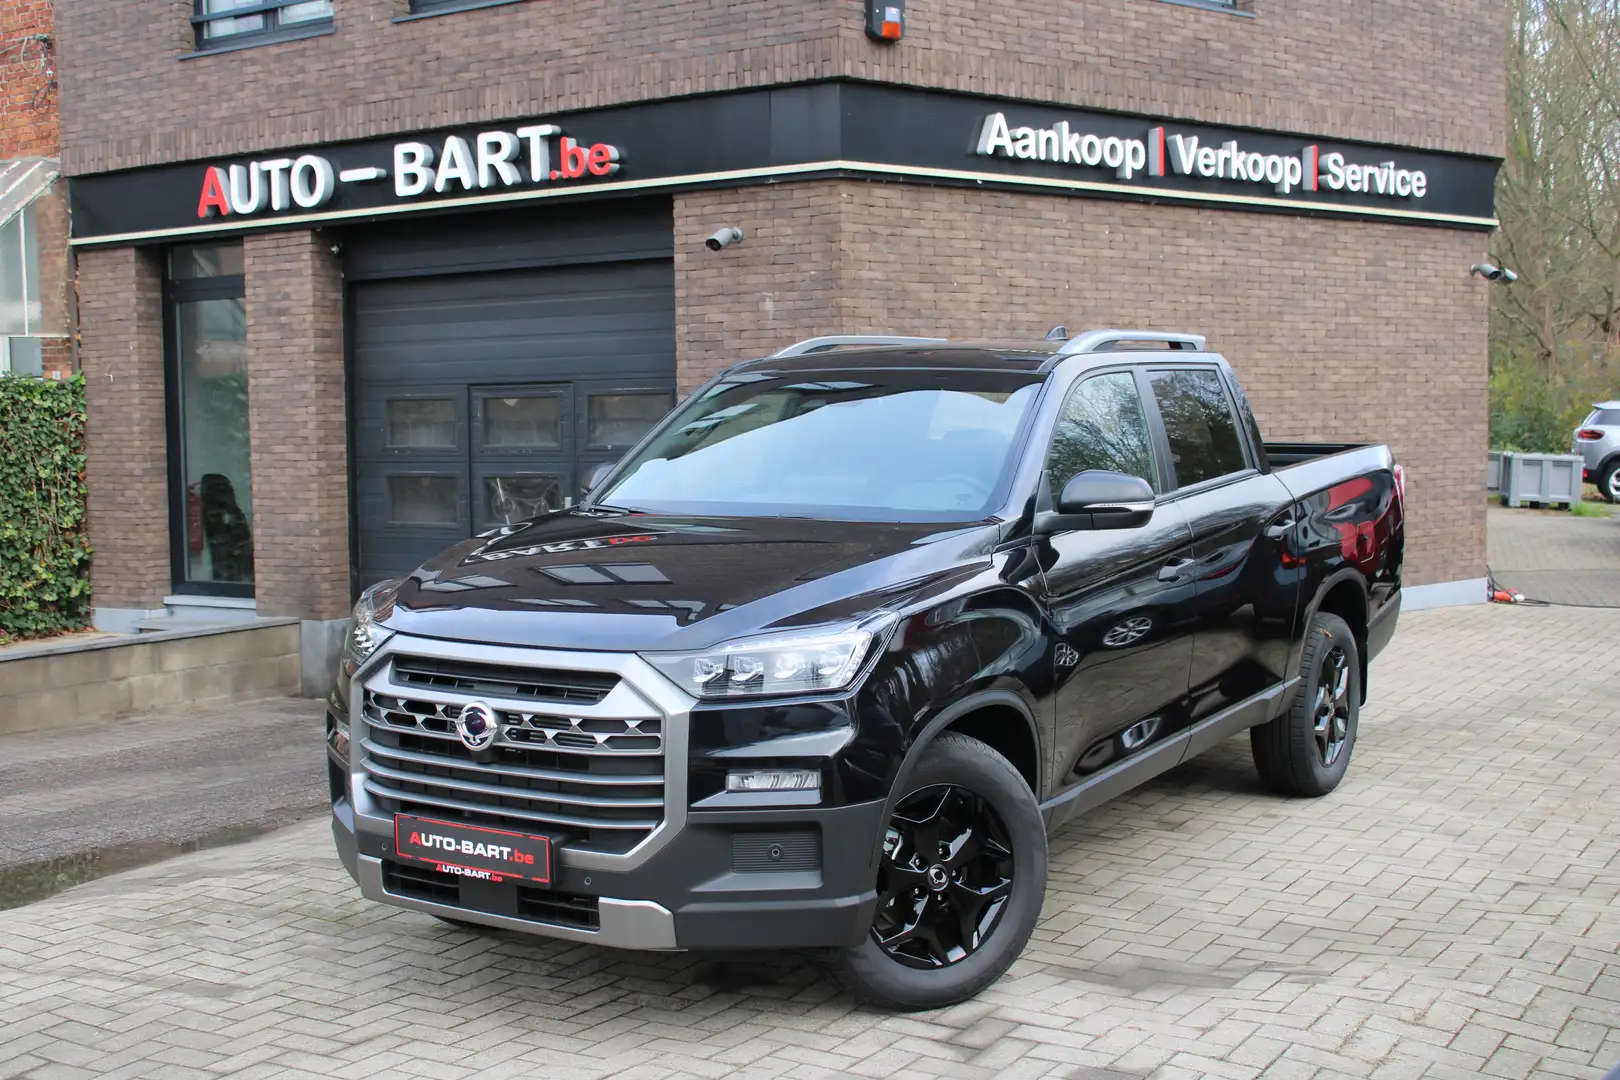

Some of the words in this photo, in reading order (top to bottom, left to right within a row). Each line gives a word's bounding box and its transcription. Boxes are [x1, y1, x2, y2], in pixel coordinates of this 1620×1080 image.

[979, 112, 1145, 179] Aankoop
[1168, 134, 1301, 194] Verkoop
[1320, 152, 1427, 197] Service
[409, 831, 535, 865] AUTO-BART.be
[435, 863, 503, 882] AUTO-BART.be
